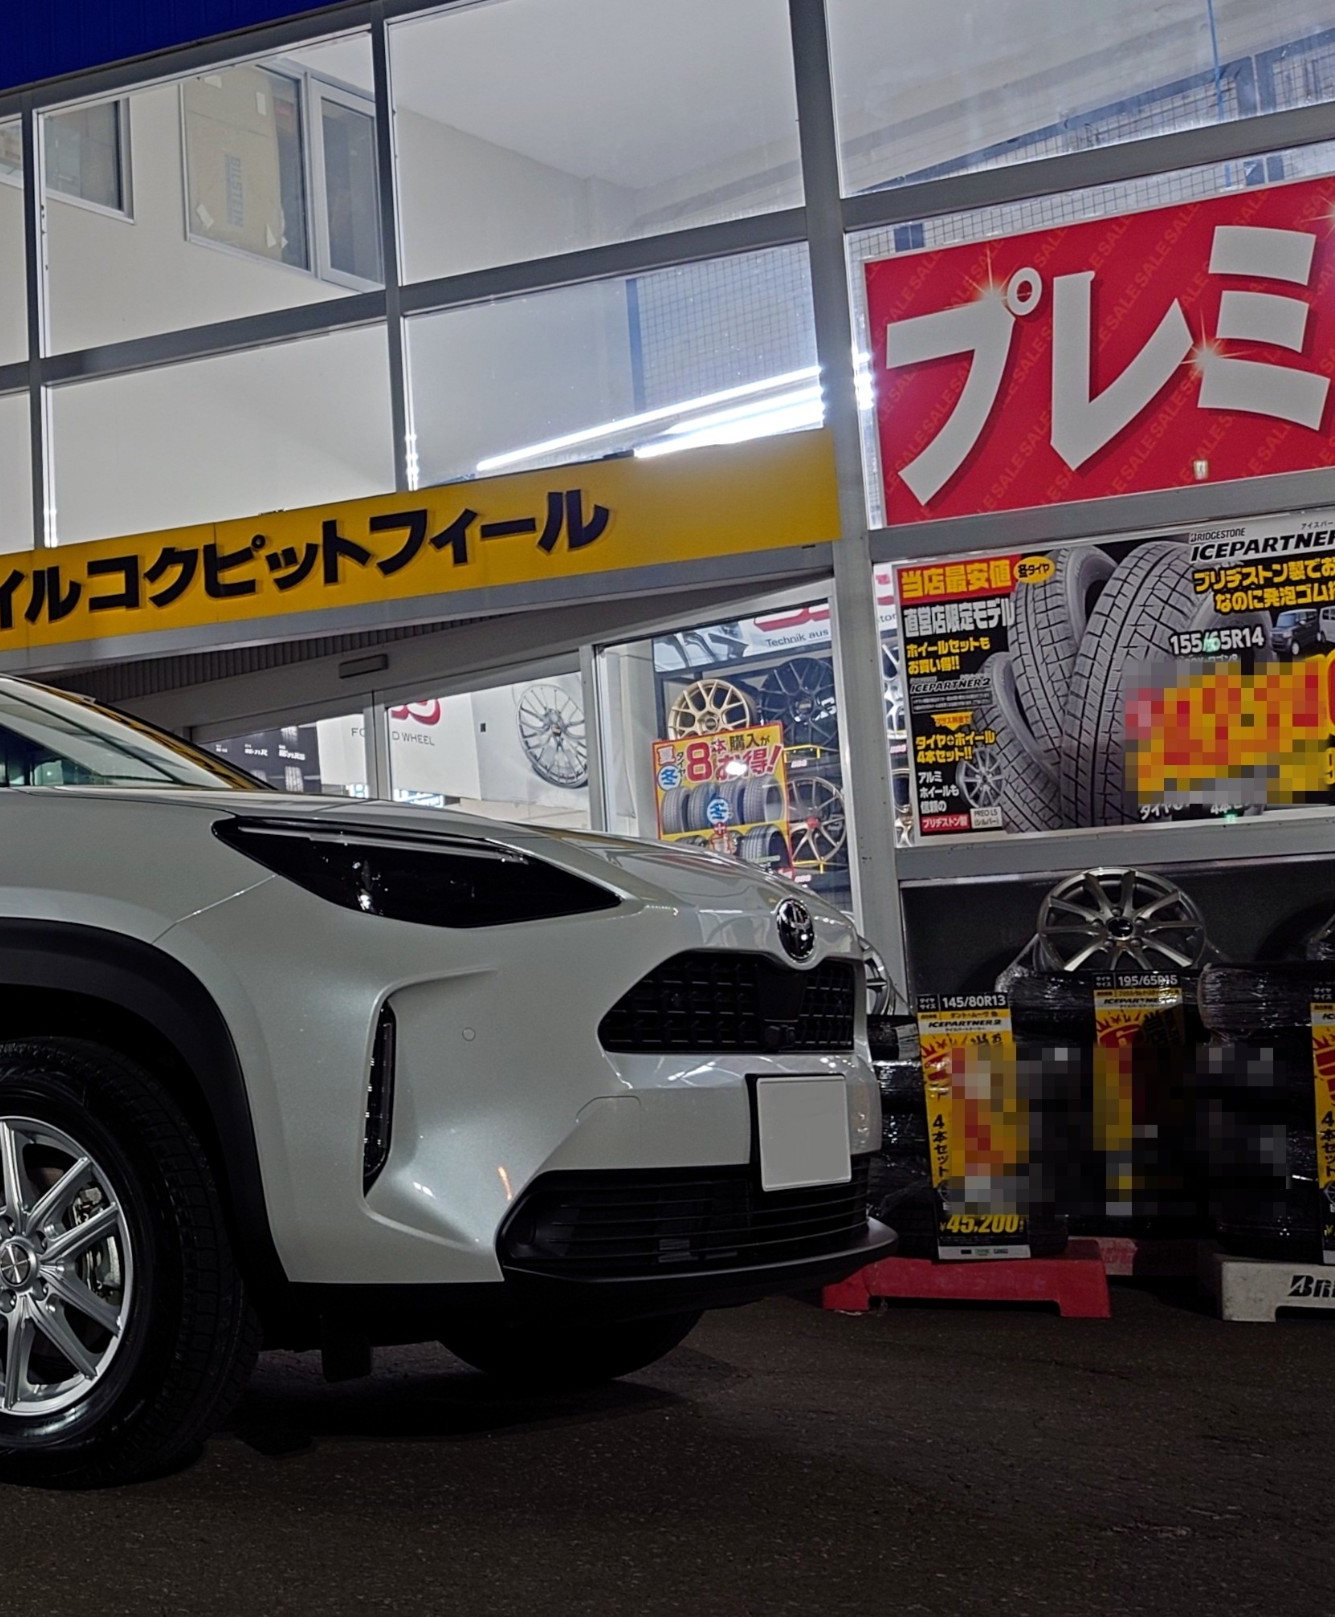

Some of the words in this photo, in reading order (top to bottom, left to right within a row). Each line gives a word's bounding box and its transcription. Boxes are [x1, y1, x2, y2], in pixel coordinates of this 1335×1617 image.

[1164, 203, 1201, 245] SALE
[1135, 242, 1172, 288] SALE
[1106, 284, 1142, 330] SALE
[886, 225, 1331, 506] プレミ
[1013, 337, 1049, 383] SALE
[922, 389, 955, 435] SALE
[1151, 391, 1188, 437] SALE
[1020, 411, 1051, 456] SALE
[992, 453, 1026, 498] SALE
[1121, 434, 1157, 480] SALE
[1190, 527, 1246, 543] BRIDGESTONE
[901, 559, 1012, 599] 当店最安値
[766, 632, 807, 648] Technik
[808, 629, 829, 640] aus
[903, 598, 1015, 638] 直営店限定モデル
[906, 637, 991, 658] ホイールセットも
[1170, 627, 1264, 655] 155/65R14
[402, 732, 435, 746] WHEEL
[918, 770, 943, 784] アルミ
[919, 784, 960, 799] ホイールも
[942, 995, 1006, 1009] 145/80R13
[932, 1114, 949, 1177] 4本セット
